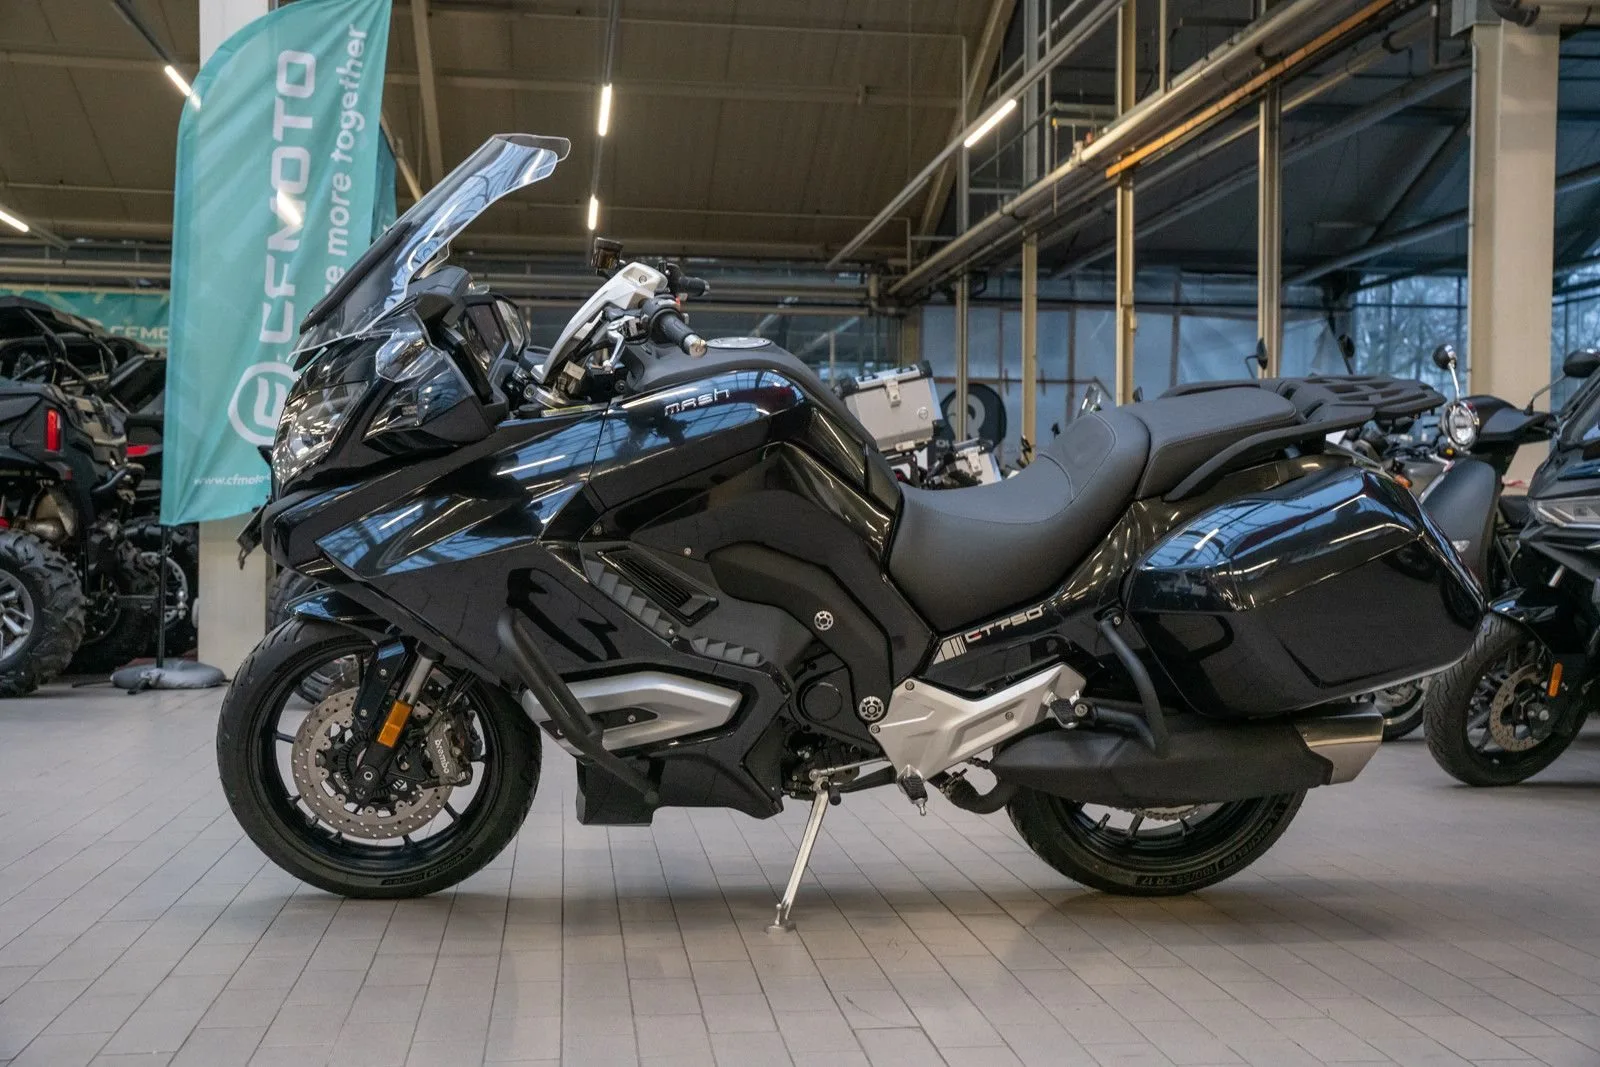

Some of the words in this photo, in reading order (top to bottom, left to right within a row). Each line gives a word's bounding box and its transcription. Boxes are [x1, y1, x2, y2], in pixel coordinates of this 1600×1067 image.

[330, 23, 367, 163] together
[259, 50, 316, 343] CFMOTO
[328, 173, 352, 256] more
[965, 604, 1045, 643] CT750
[435, 739, 450, 774] brembo
